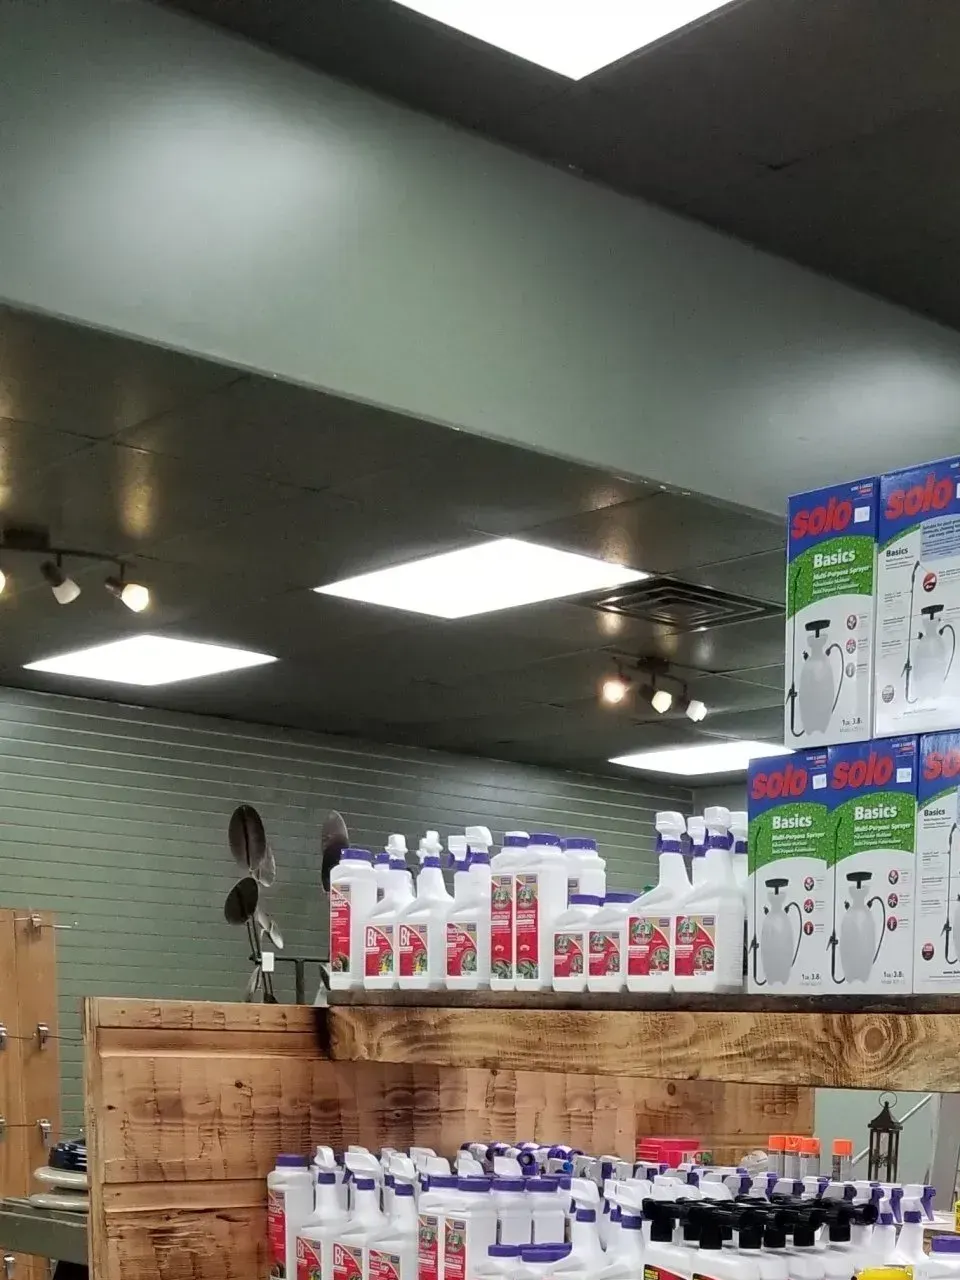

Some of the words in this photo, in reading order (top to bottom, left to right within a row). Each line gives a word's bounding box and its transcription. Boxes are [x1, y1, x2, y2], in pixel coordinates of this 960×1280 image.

[885, 471, 955, 520] solo
[792, 497, 852, 539] solo
[813, 549, 856, 568] Basics
[886, 547, 908, 557] Basics
[831, 750, 893, 790] solo
[751, 761, 807, 799] solo
[772, 813, 812, 829] Basics
[854, 804, 897, 820] Basics
[924, 808, 945, 816] Basics
[367, 928, 377, 947] Bt
[400, 927, 411, 946] Bt
[334, 1247, 344, 1265] Bt
